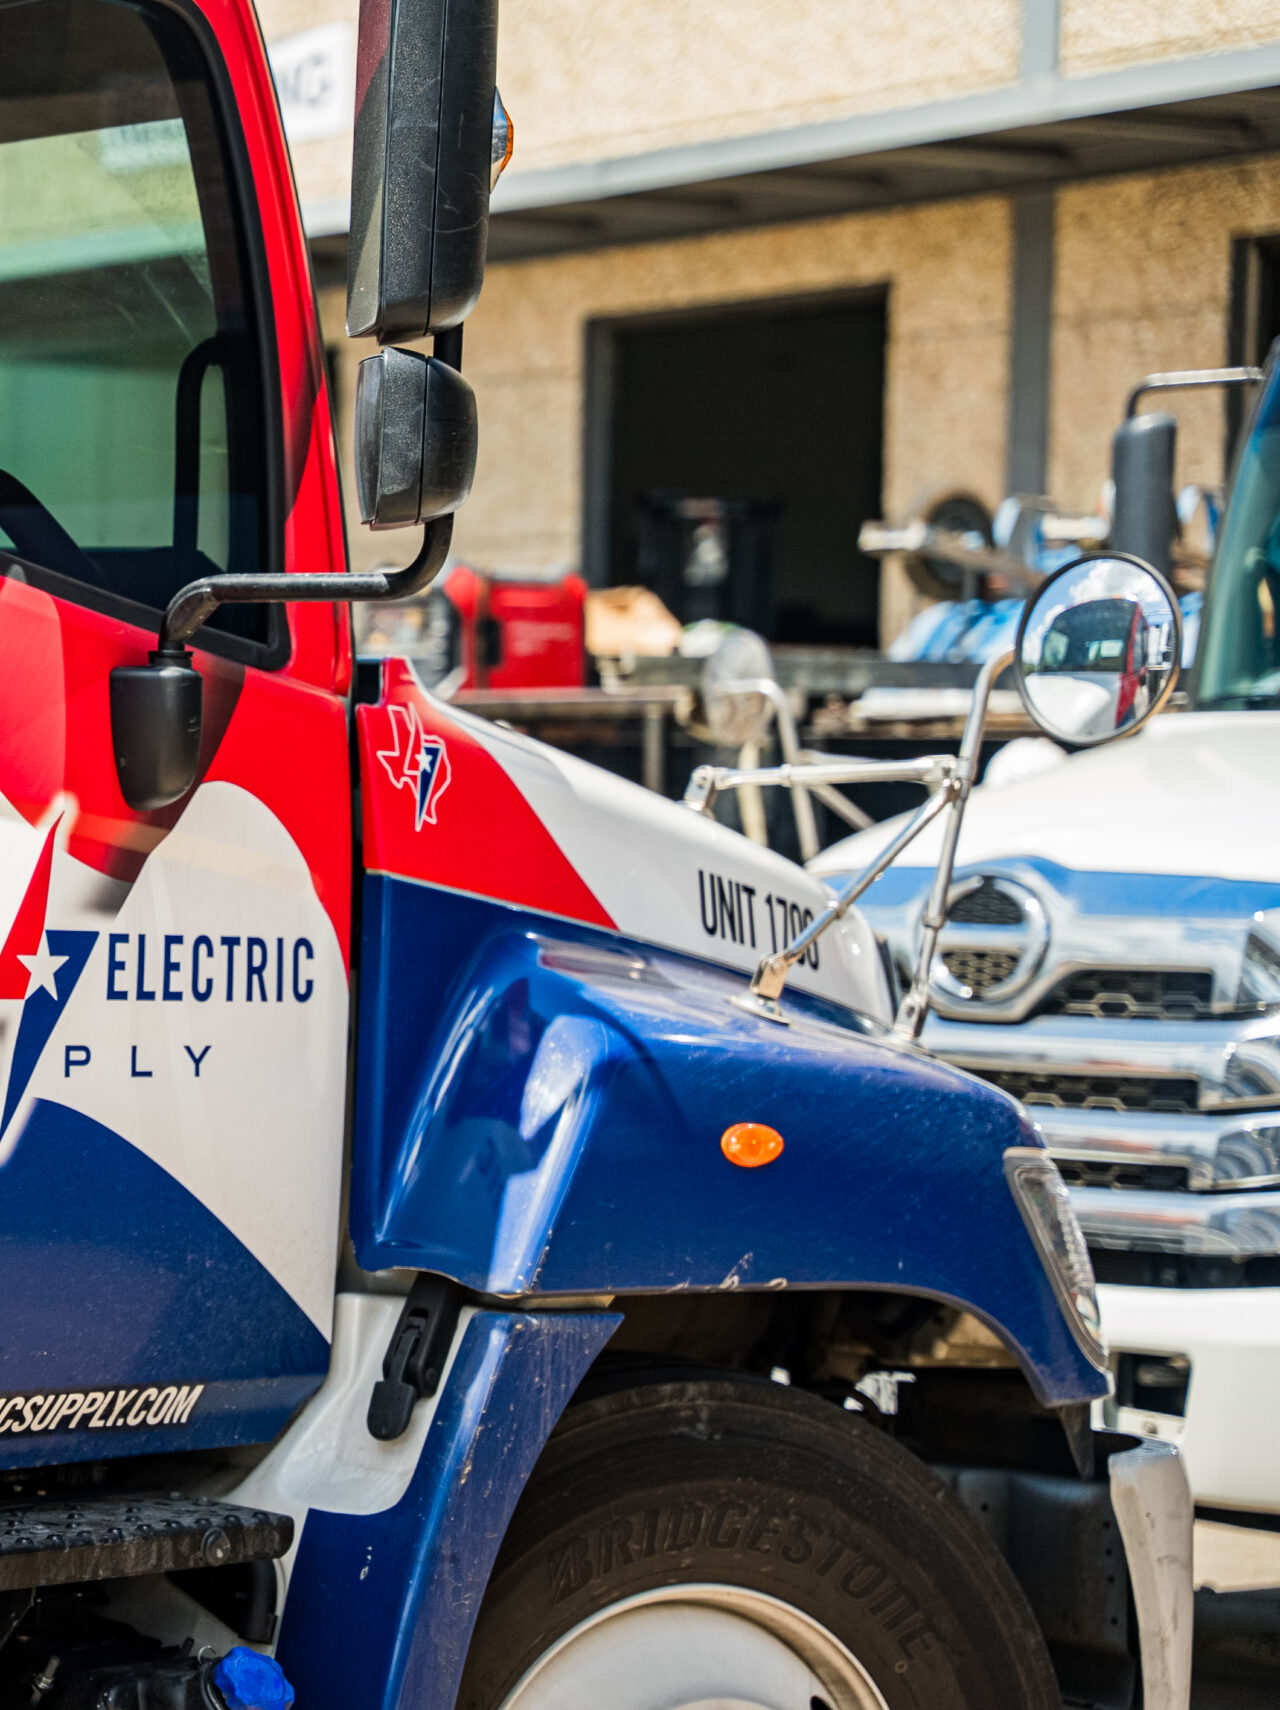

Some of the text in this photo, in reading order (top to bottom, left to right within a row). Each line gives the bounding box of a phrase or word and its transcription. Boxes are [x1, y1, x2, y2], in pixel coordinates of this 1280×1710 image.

[698, 869, 756, 949] UNIT
[106, 933, 315, 1003] ELECTRIC
[547, 1499, 934, 1660] BRIDGESTONE
